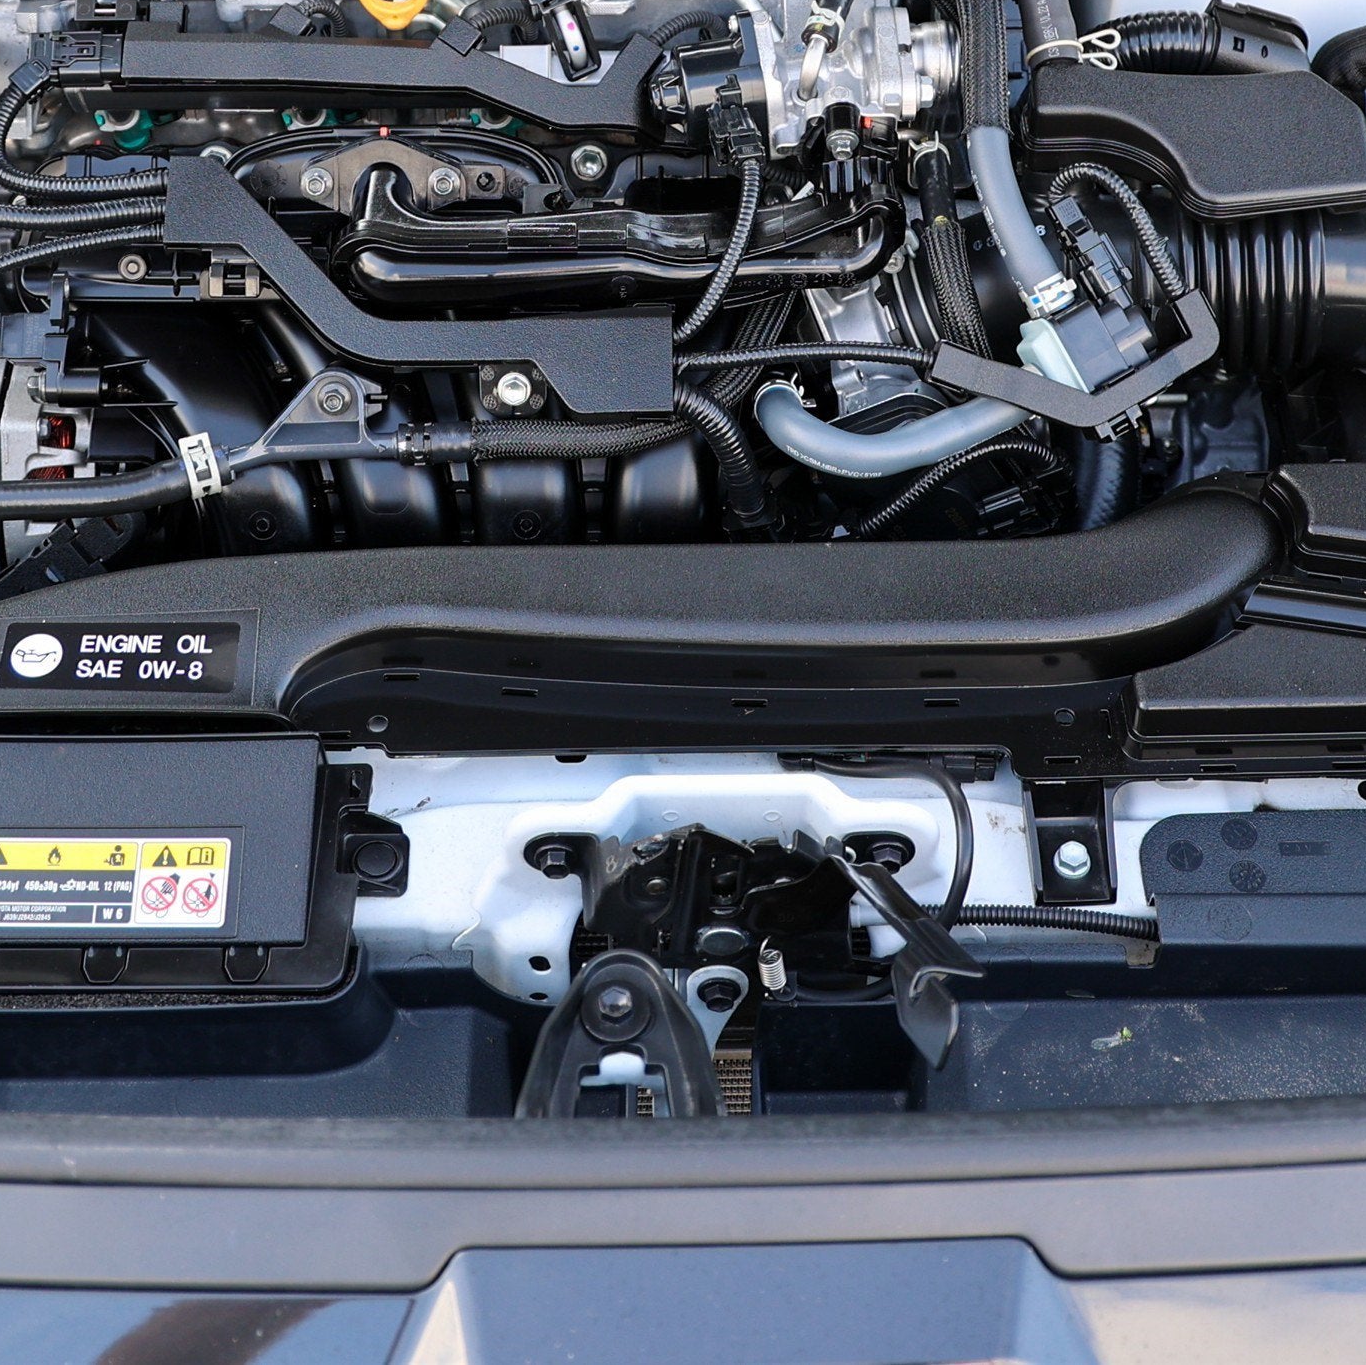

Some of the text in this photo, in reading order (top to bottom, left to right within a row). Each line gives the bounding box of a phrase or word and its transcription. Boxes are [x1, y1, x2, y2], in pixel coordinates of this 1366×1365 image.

[79, 634, 213, 654] ENGINE OIL
[75, 658, 203, 680] SAE 0W-8
[76, 880, 100, 891] ND-OIL
[104, 880, 113, 891] 12
[113, 880, 133, 894] (PAG)
[11, 905, 31, 913] MOTOR
[30, 905, 67, 913] CORPORATION
[102, 907, 123, 920] W 6
